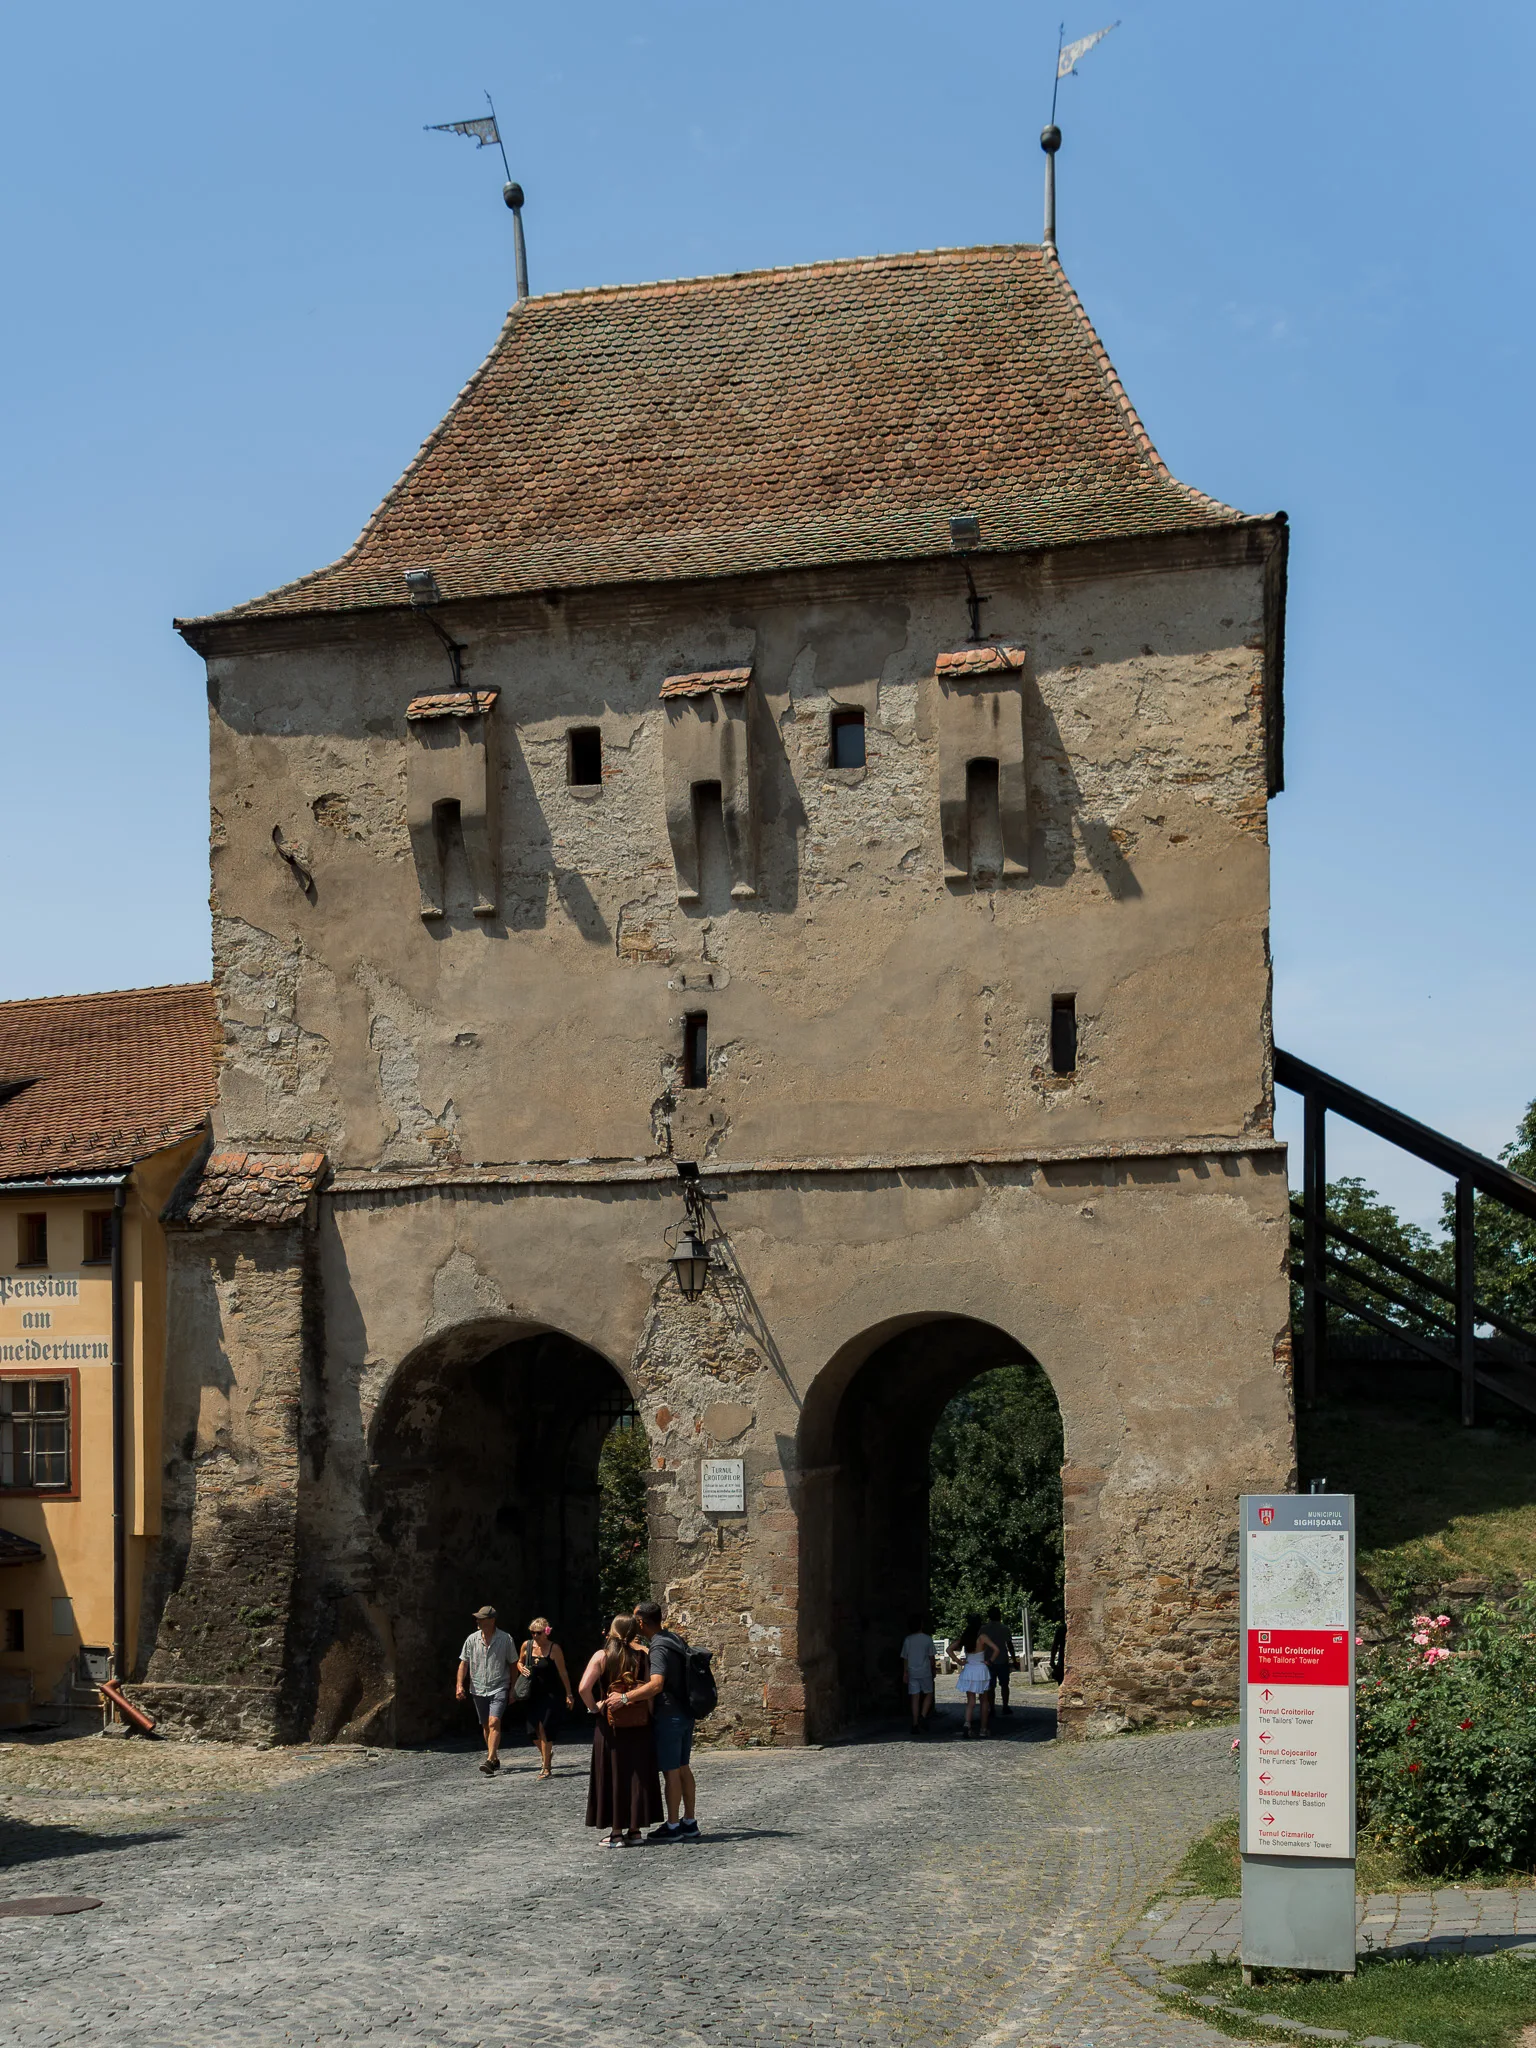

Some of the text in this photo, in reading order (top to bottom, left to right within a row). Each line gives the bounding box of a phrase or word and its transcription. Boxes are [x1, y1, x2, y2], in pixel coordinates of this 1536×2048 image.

[0, 1275, 78, 1305] Pension
[22, 1312, 51, 1328] am
[0, 1338, 108, 1363] neiderturm
[1259, 1789, 1290, 1797] Bastionul
[1281, 1831, 1314, 1839] Cizmarilor
